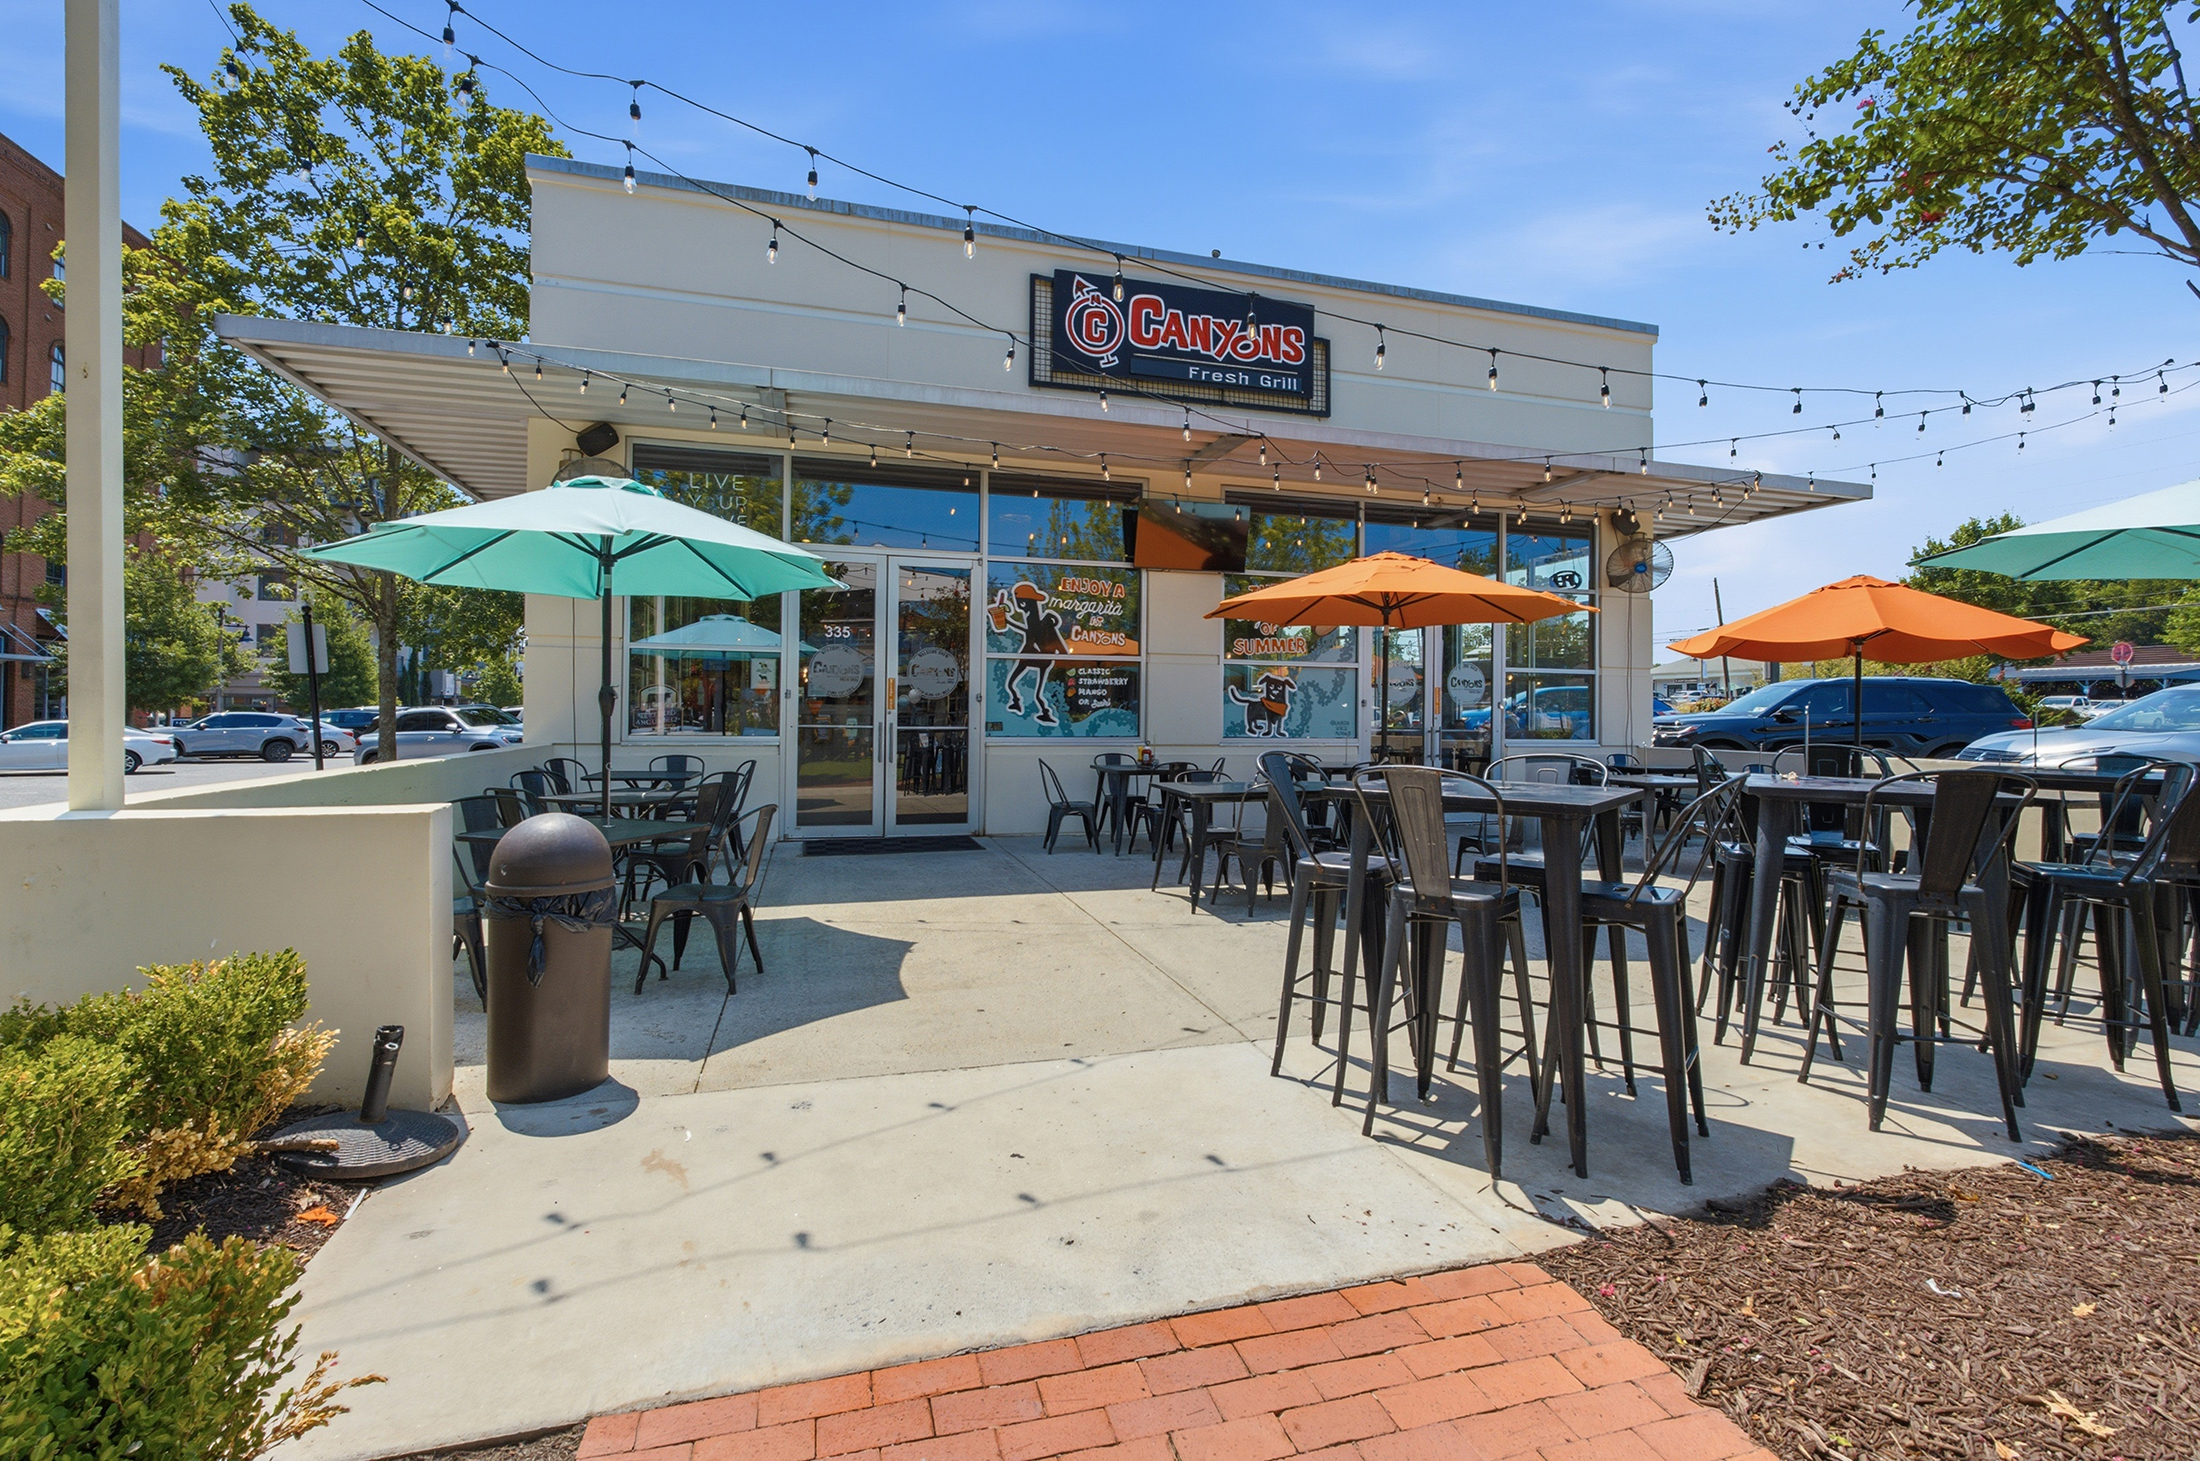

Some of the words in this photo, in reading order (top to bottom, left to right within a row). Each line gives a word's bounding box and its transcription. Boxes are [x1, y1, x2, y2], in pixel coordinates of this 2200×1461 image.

[1128, 294, 1305, 365] CANYONS
[1189, 366, 1249, 385] Fresh
[1260, 375, 1297, 390] Grill
[689, 472, 745, 491] LIVE
[1061, 577, 1112, 597] ENJOY
[1113, 583, 1126, 598] A
[1048, 597, 1124, 619] margarita
[824, 626, 851, 639] 335
[1071, 625, 1126, 646] CANYONS
[1233, 637, 1307, 656] SUMMER
[1078, 667, 1111, 675] CLASSIC
[1078, 677, 1128, 686] STRAWBERRY
[1078, 688, 1107, 696] MANGO
